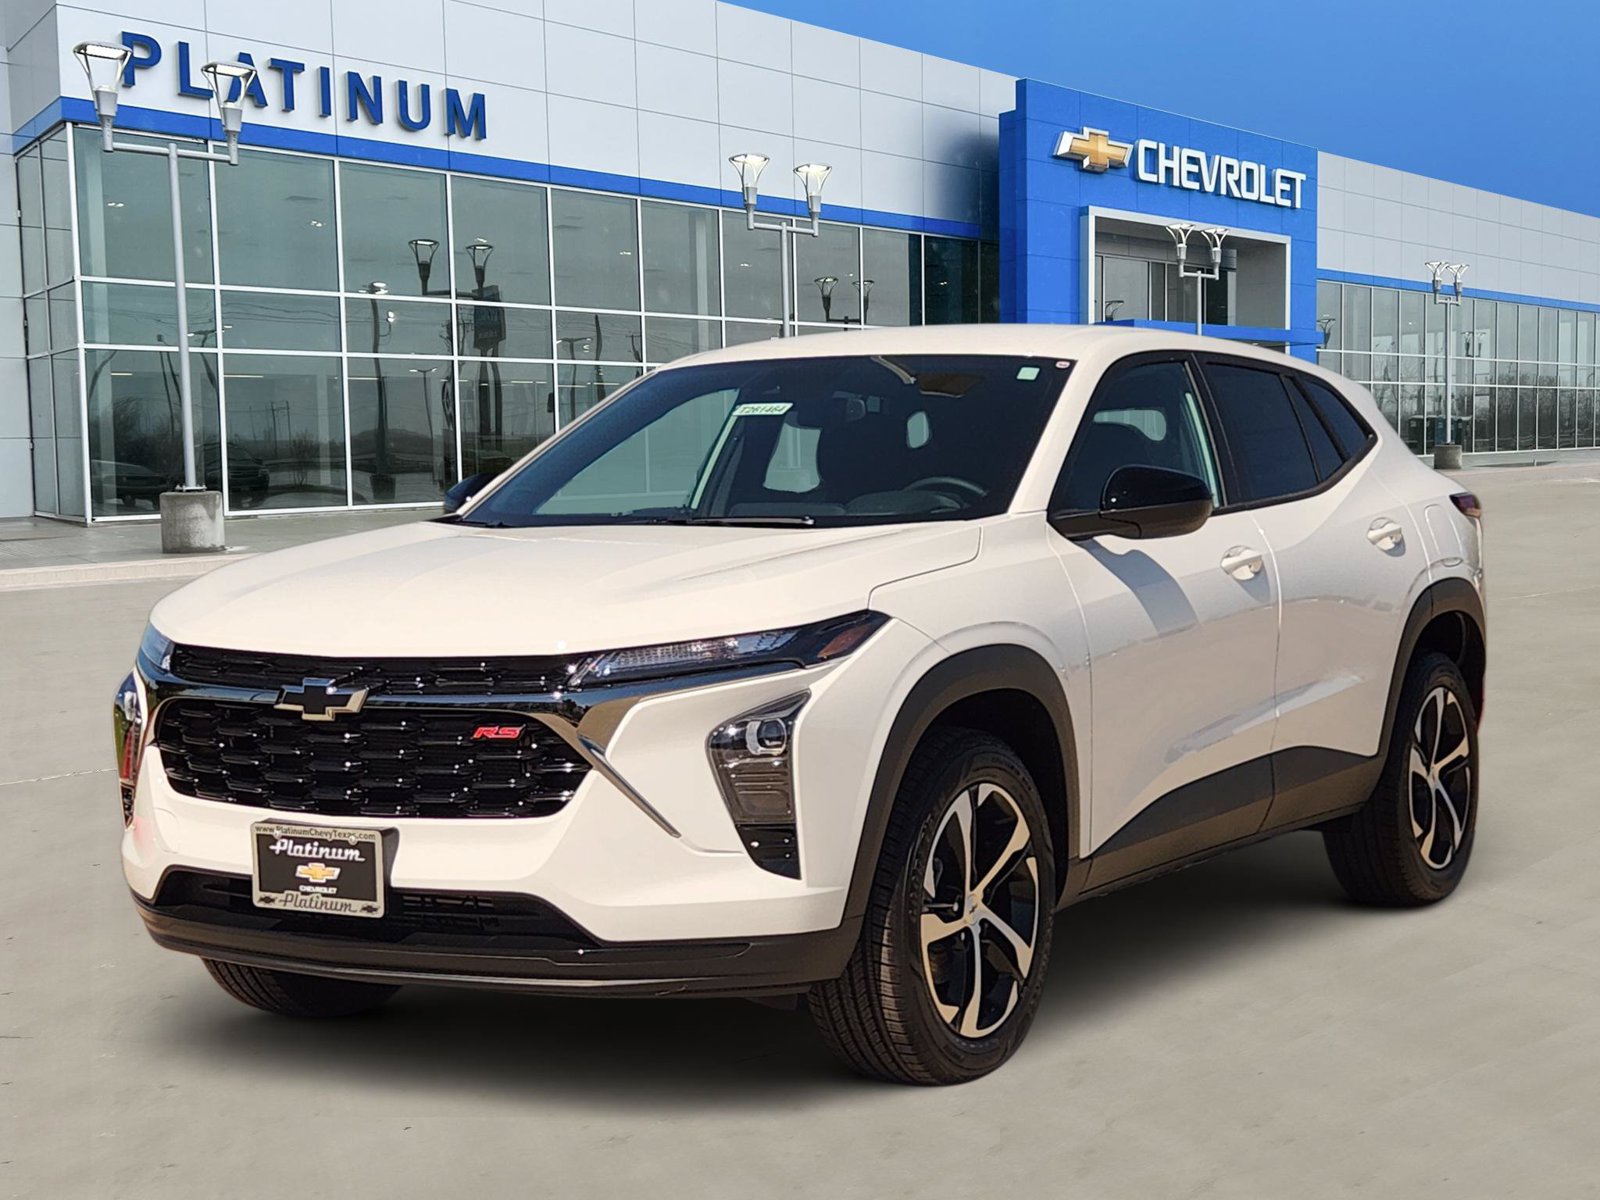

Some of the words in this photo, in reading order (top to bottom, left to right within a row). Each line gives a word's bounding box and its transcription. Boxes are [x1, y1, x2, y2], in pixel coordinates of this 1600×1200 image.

[121, 31, 486, 141] PLATINUM
[1135, 138, 1306, 209] CHEVROLET
[473, 726, 521, 739] RS
[269, 838, 366, 862] Platinum
[299, 884, 337, 894] CHEVROLET
[278, 892, 358, 913] Platinum
